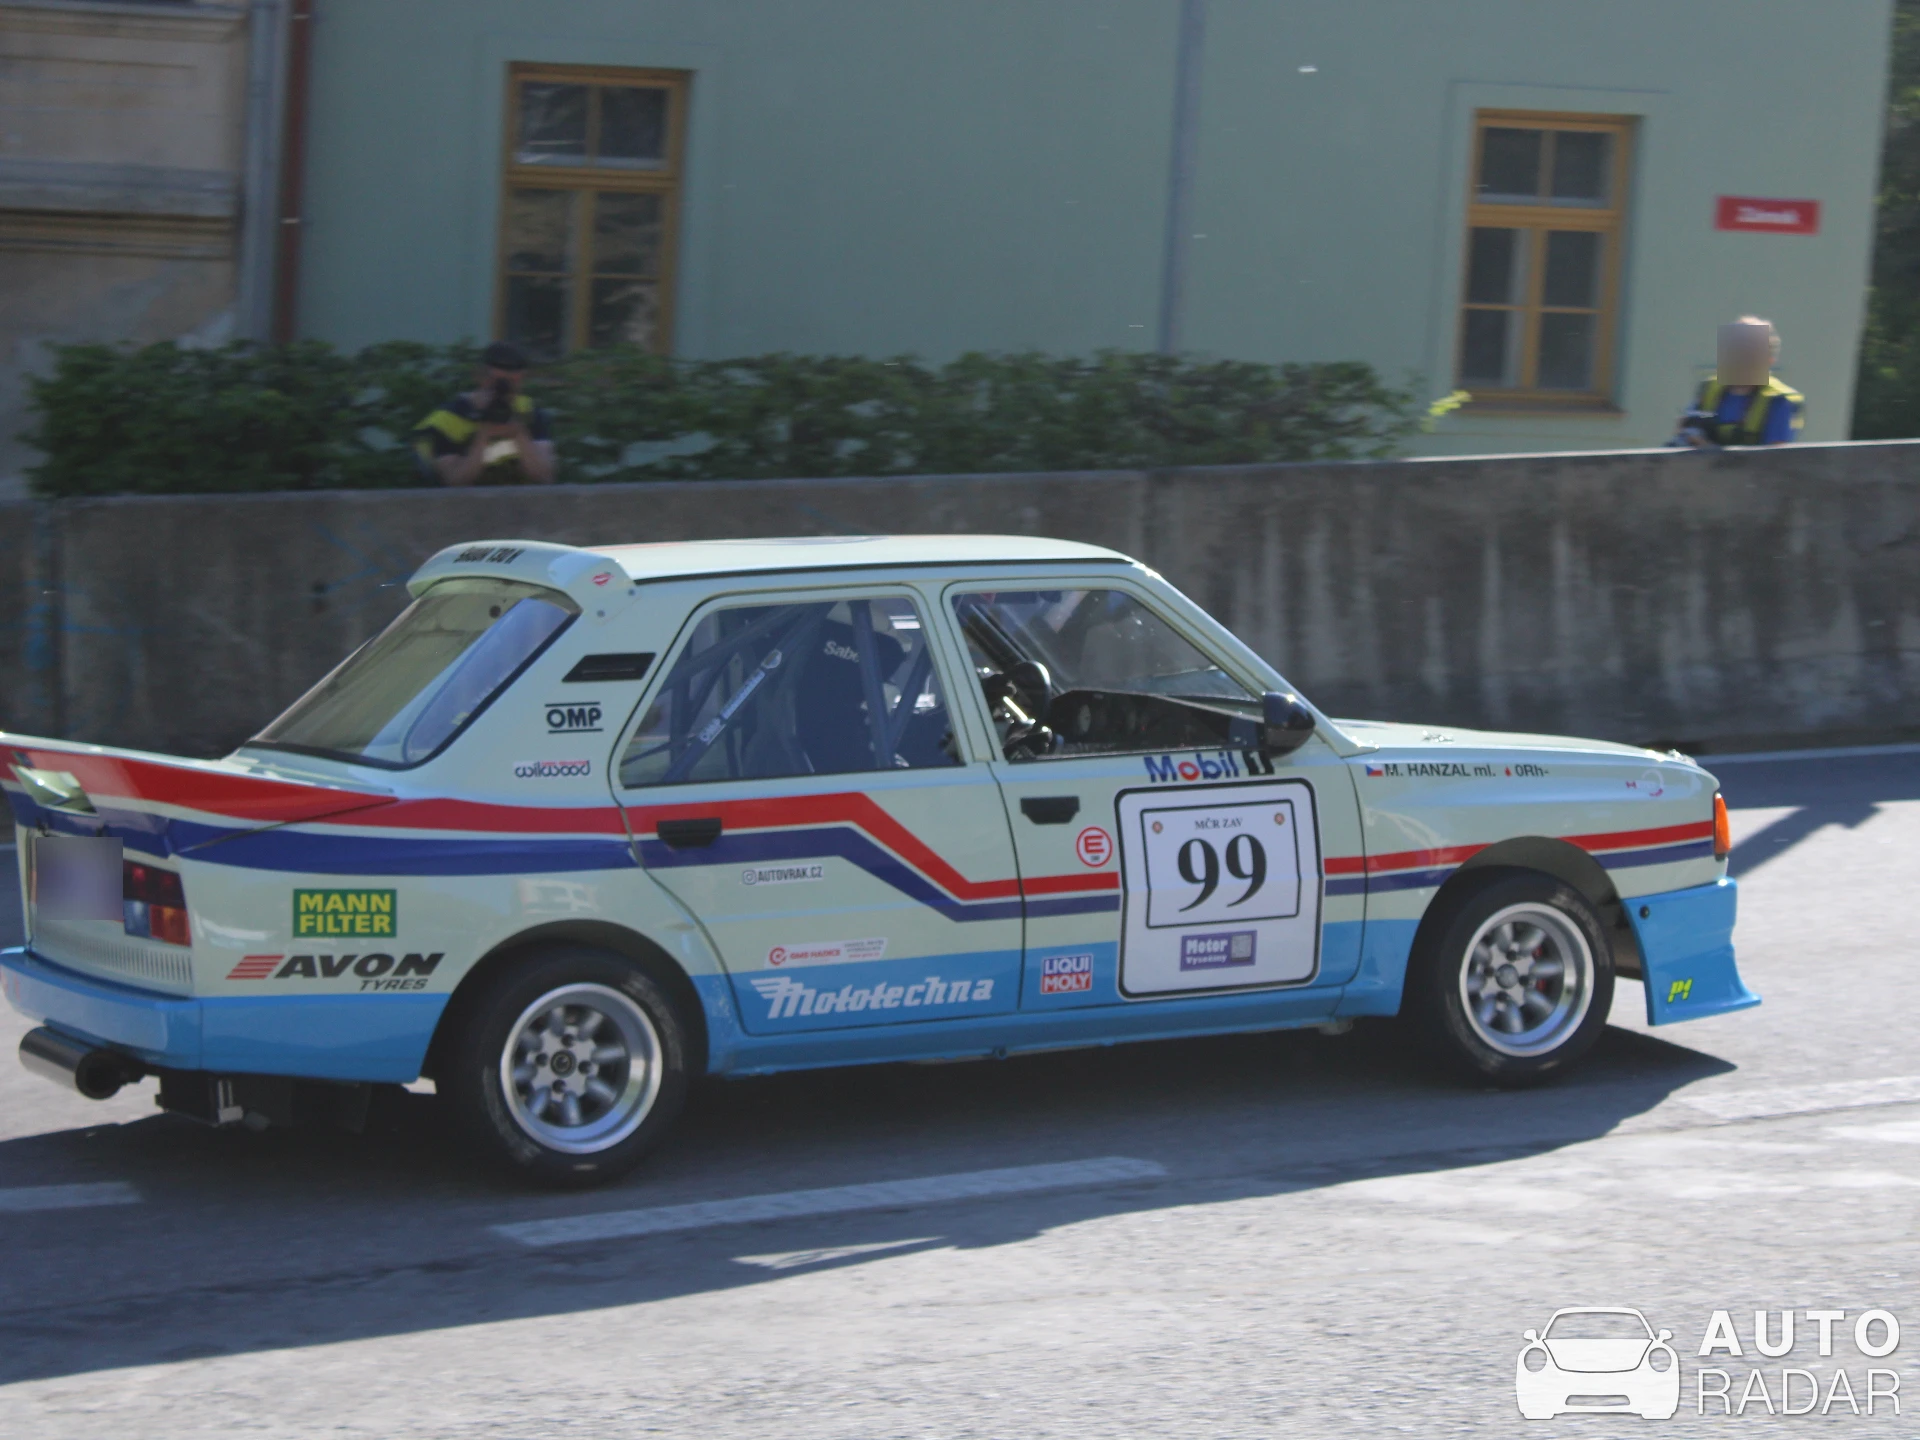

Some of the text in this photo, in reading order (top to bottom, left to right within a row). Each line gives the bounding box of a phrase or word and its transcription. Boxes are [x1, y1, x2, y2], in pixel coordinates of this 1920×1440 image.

[546, 707, 602, 728] OMP
[515, 760, 591, 778] wilwood
[1143, 750, 1240, 783] Mobil
[1385, 763, 1403, 777] M.
[1407, 763, 1471, 777] HANZAL
[1474, 763, 1496, 777] ml.
[1195, 817, 1243, 830] MČR ZAV
[758, 866, 823, 882] AUTOVRAK.CZ
[1177, 834, 1267, 912] 99
[300, 893, 391, 913] MANN
[300, 914, 391, 933] FILTER
[1186, 938, 1228, 955] Motor
[274, 953, 445, 979] AVON
[1045, 957, 1089, 975] LIQUI
[360, 979, 429, 992] TYRES
[1044, 974, 1090, 991] MOLY
[751, 975, 994, 1019] Mototechna
